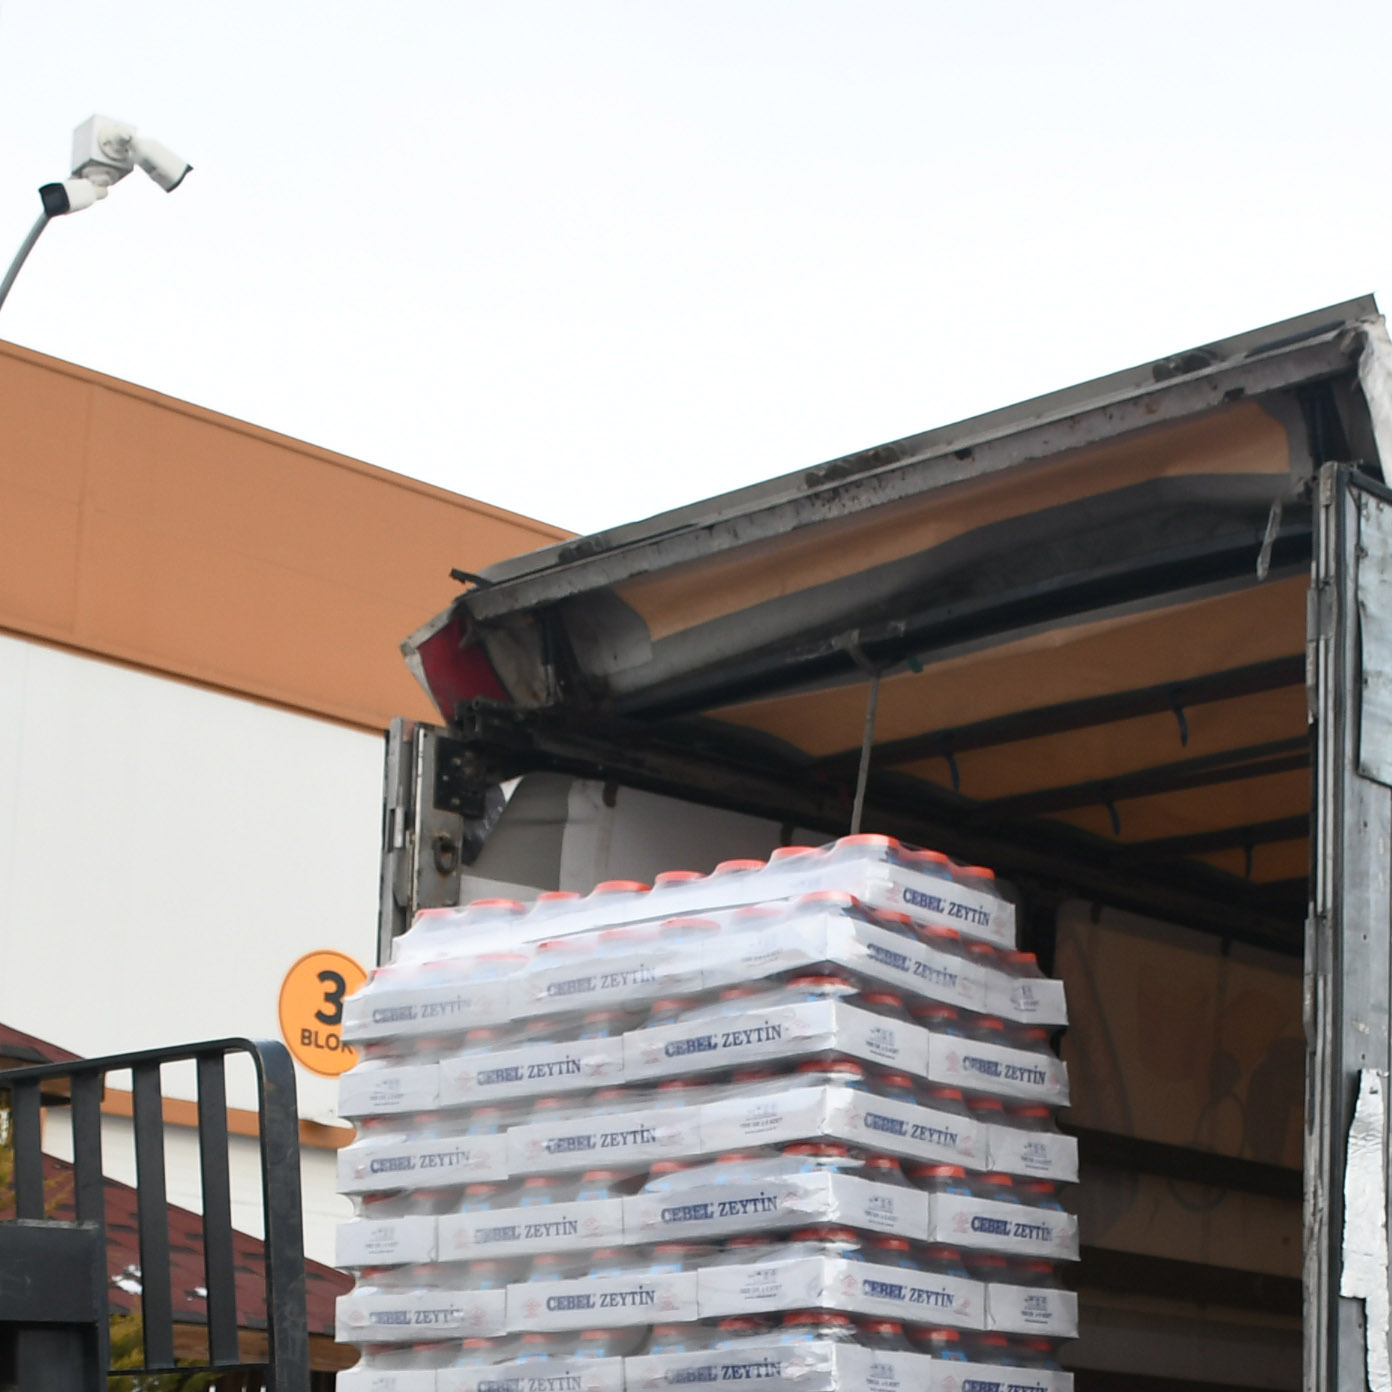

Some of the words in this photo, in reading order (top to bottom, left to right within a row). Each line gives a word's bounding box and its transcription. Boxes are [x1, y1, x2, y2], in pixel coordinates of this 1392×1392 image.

[903, 888, 945, 913] CEBEL
[948, 902, 990, 926] ZEYTİN
[547, 976, 596, 997] CEBEL
[599, 963, 655, 990] ZEYTİN
[914, 960, 958, 987] ZEYTİN
[315, 970, 346, 1026] 3
[372, 1007, 416, 1025] CEBEL
[665, 1035, 718, 1058] CEBEL
[721, 1020, 782, 1047] ZEYTİN
[527, 1054, 581, 1079] ZEYTİN
[962, 1056, 1002, 1078] CEBEL
[1004, 1061, 1045, 1085] ZEYTİN
[600, 1123, 656, 1148] ZEYTİN
[864, 1112, 907, 1136] CEBEL
[910, 1120, 957, 1146] ZEYTİN
[370, 1155, 415, 1174] CEBEL
[661, 1203, 713, 1223] CEBEL
[717, 1192, 777, 1217] ZEYTİN
[524, 1216, 578, 1238] ZEYTİN
[971, 1215, 1011, 1235] CEBEL
[546, 1294, 596, 1312] CEBEL
[599, 1286, 655, 1308] ZEYTİN
[862, 1279, 908, 1300] CEBEL
[909, 1287, 954, 1307] ZEYTİN
[528, 1371, 581, 1392] ZEYTİN
